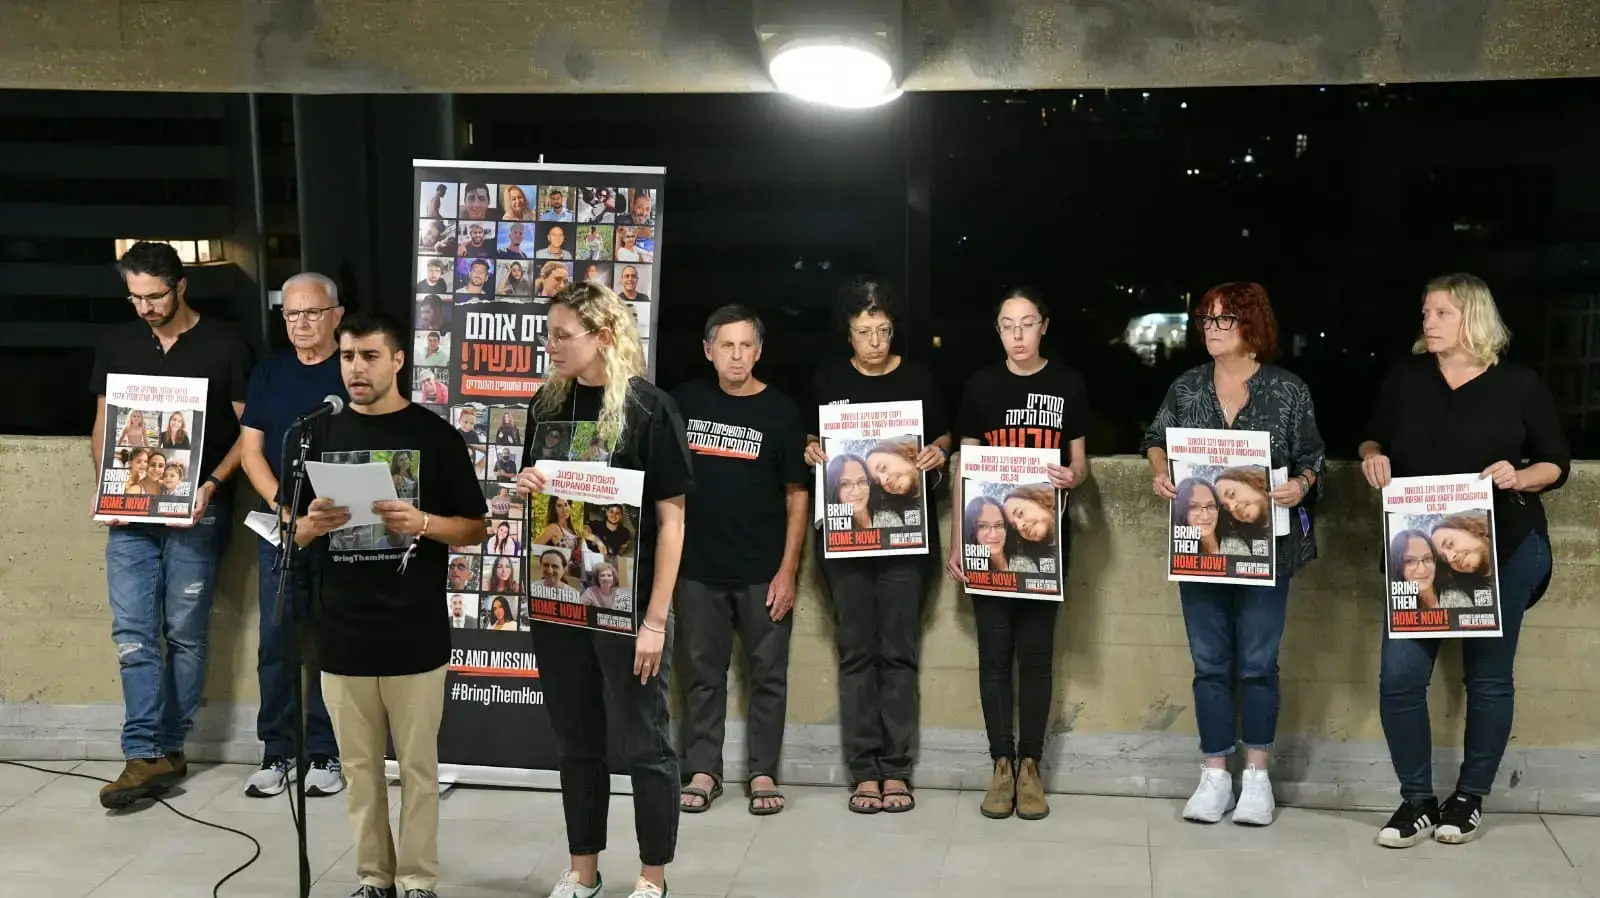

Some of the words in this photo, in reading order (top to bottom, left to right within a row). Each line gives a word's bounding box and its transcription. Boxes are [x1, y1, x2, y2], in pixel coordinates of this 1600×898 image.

[466, 312, 516, 341] אותם
[1026, 393, 1064, 413] מחזירים
[1005, 409, 1037, 426] הביתה
[1039, 410, 1062, 429] אותם
[720, 436, 761, 457] החטופים
[104, 469, 130, 481] BRING
[103, 482, 126, 494] THEM
[552, 479, 590, 492] TRUPANOB
[593, 485, 619, 495] FAMILY
[101, 496, 124, 508] HOME
[125, 496, 150, 510] NOW!
[828, 503, 854, 516] BRING
[828, 517, 851, 530] THEM
[829, 531, 853, 545] HOME
[856, 529, 880, 544] NOW!
[1174, 526, 1200, 540] BRING
[965, 544, 990, 557] BRING
[1174, 540, 1198, 553] THEM
[965, 558, 988, 570] THEM
[1174, 556, 1198, 569] HOME
[1201, 556, 1226, 570] NOW!
[967, 572, 990, 584] HOME
[992, 573, 1016, 586] NOW!
[530, 584, 557, 599] BRING
[558, 588, 580, 604] THEM
[1391, 581, 1419, 594] BRING
[531, 599, 559, 615] HOME
[560, 603, 587, 620] NOW!
[1392, 596, 1417, 609] THEM
[1392, 611, 1419, 625] HOME
[1421, 609, 1448, 625] NOW!
[465, 650, 488, 668] AND
